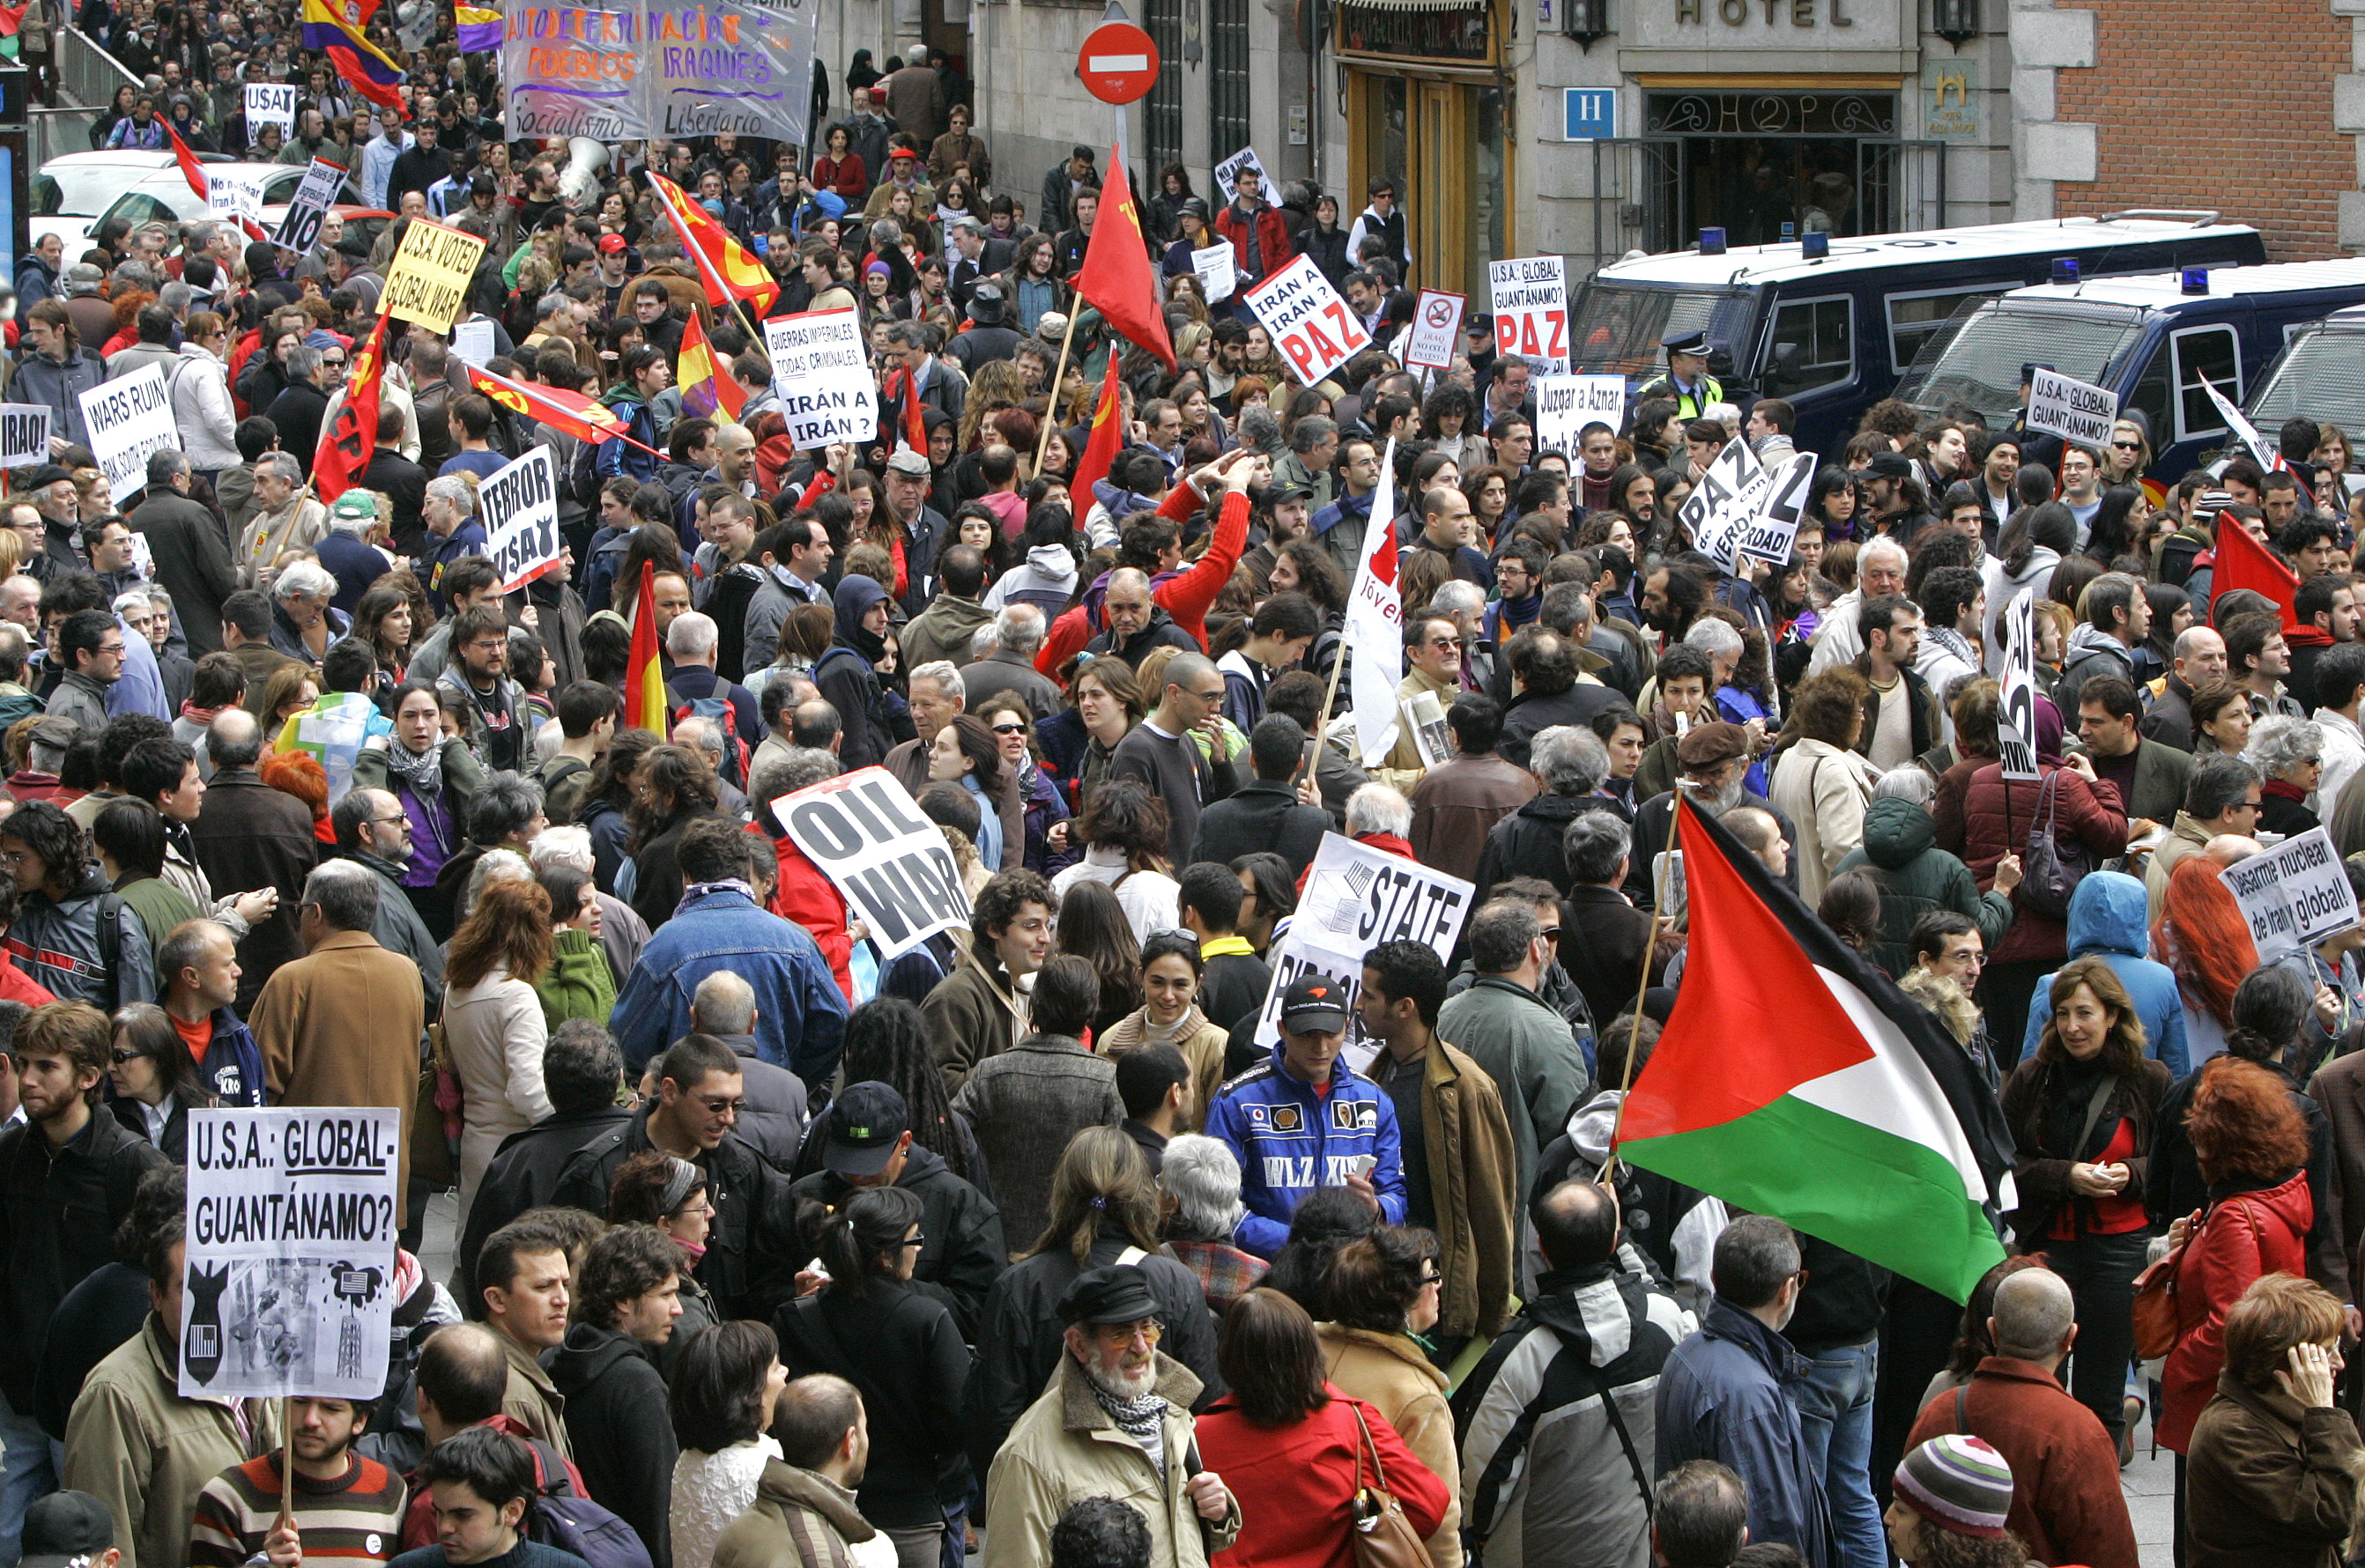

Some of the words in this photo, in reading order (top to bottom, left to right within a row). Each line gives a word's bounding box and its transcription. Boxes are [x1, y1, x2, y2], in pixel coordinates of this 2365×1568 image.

[1674, 0, 1854, 26] HOTEL
[527, 47, 636, 81] PUEBLOS
[1580, 94, 1601, 121] H
[211, 178, 224, 190] No
[274, 201, 323, 252] NO
[436, 233, 479, 275] VOTED
[386, 270, 432, 312] GLOBAL
[427, 283, 460, 323] WAR
[1255, 277, 1302, 316] IRÁN
[1305, 269, 1319, 284] A
[1270, 294, 1316, 334] IRÁN
[771, 328, 809, 351] GUERRAS
[1280, 300, 1366, 381] PAZ
[1495, 309, 1567, 358] PAZ
[88, 391, 130, 434] WARS
[130, 377, 167, 416] RUIN
[786, 388, 846, 416] IRÁN
[855, 391, 869, 408] A
[1541, 381, 1575, 419] Juzgar
[1578, 388, 1584, 410] a
[795, 413, 852, 441] IRÁN
[2033, 405, 2109, 441] GUANTÁNAMO?
[482, 457, 551, 536] TERROR
[1682, 439, 1761, 541] PAZ
[1739, 478, 1767, 503] con
[1712, 507, 1762, 566] VERDA
[1742, 527, 1790, 554] RDAD!
[791, 780, 930, 861] OIL
[2226, 859, 2279, 898] Desarme
[2279, 841, 2329, 878] nuclear
[842, 847, 970, 945] WAR
[2252, 911, 2268, 943] de
[2264, 906, 2290, 936] Iran
[2286, 904, 2298, 935] y
[2296, 877, 2349, 930] global!
[1263, 1157, 1316, 1187] WLZ
[196, 1181, 393, 1245] GUANTÁNAMO?
